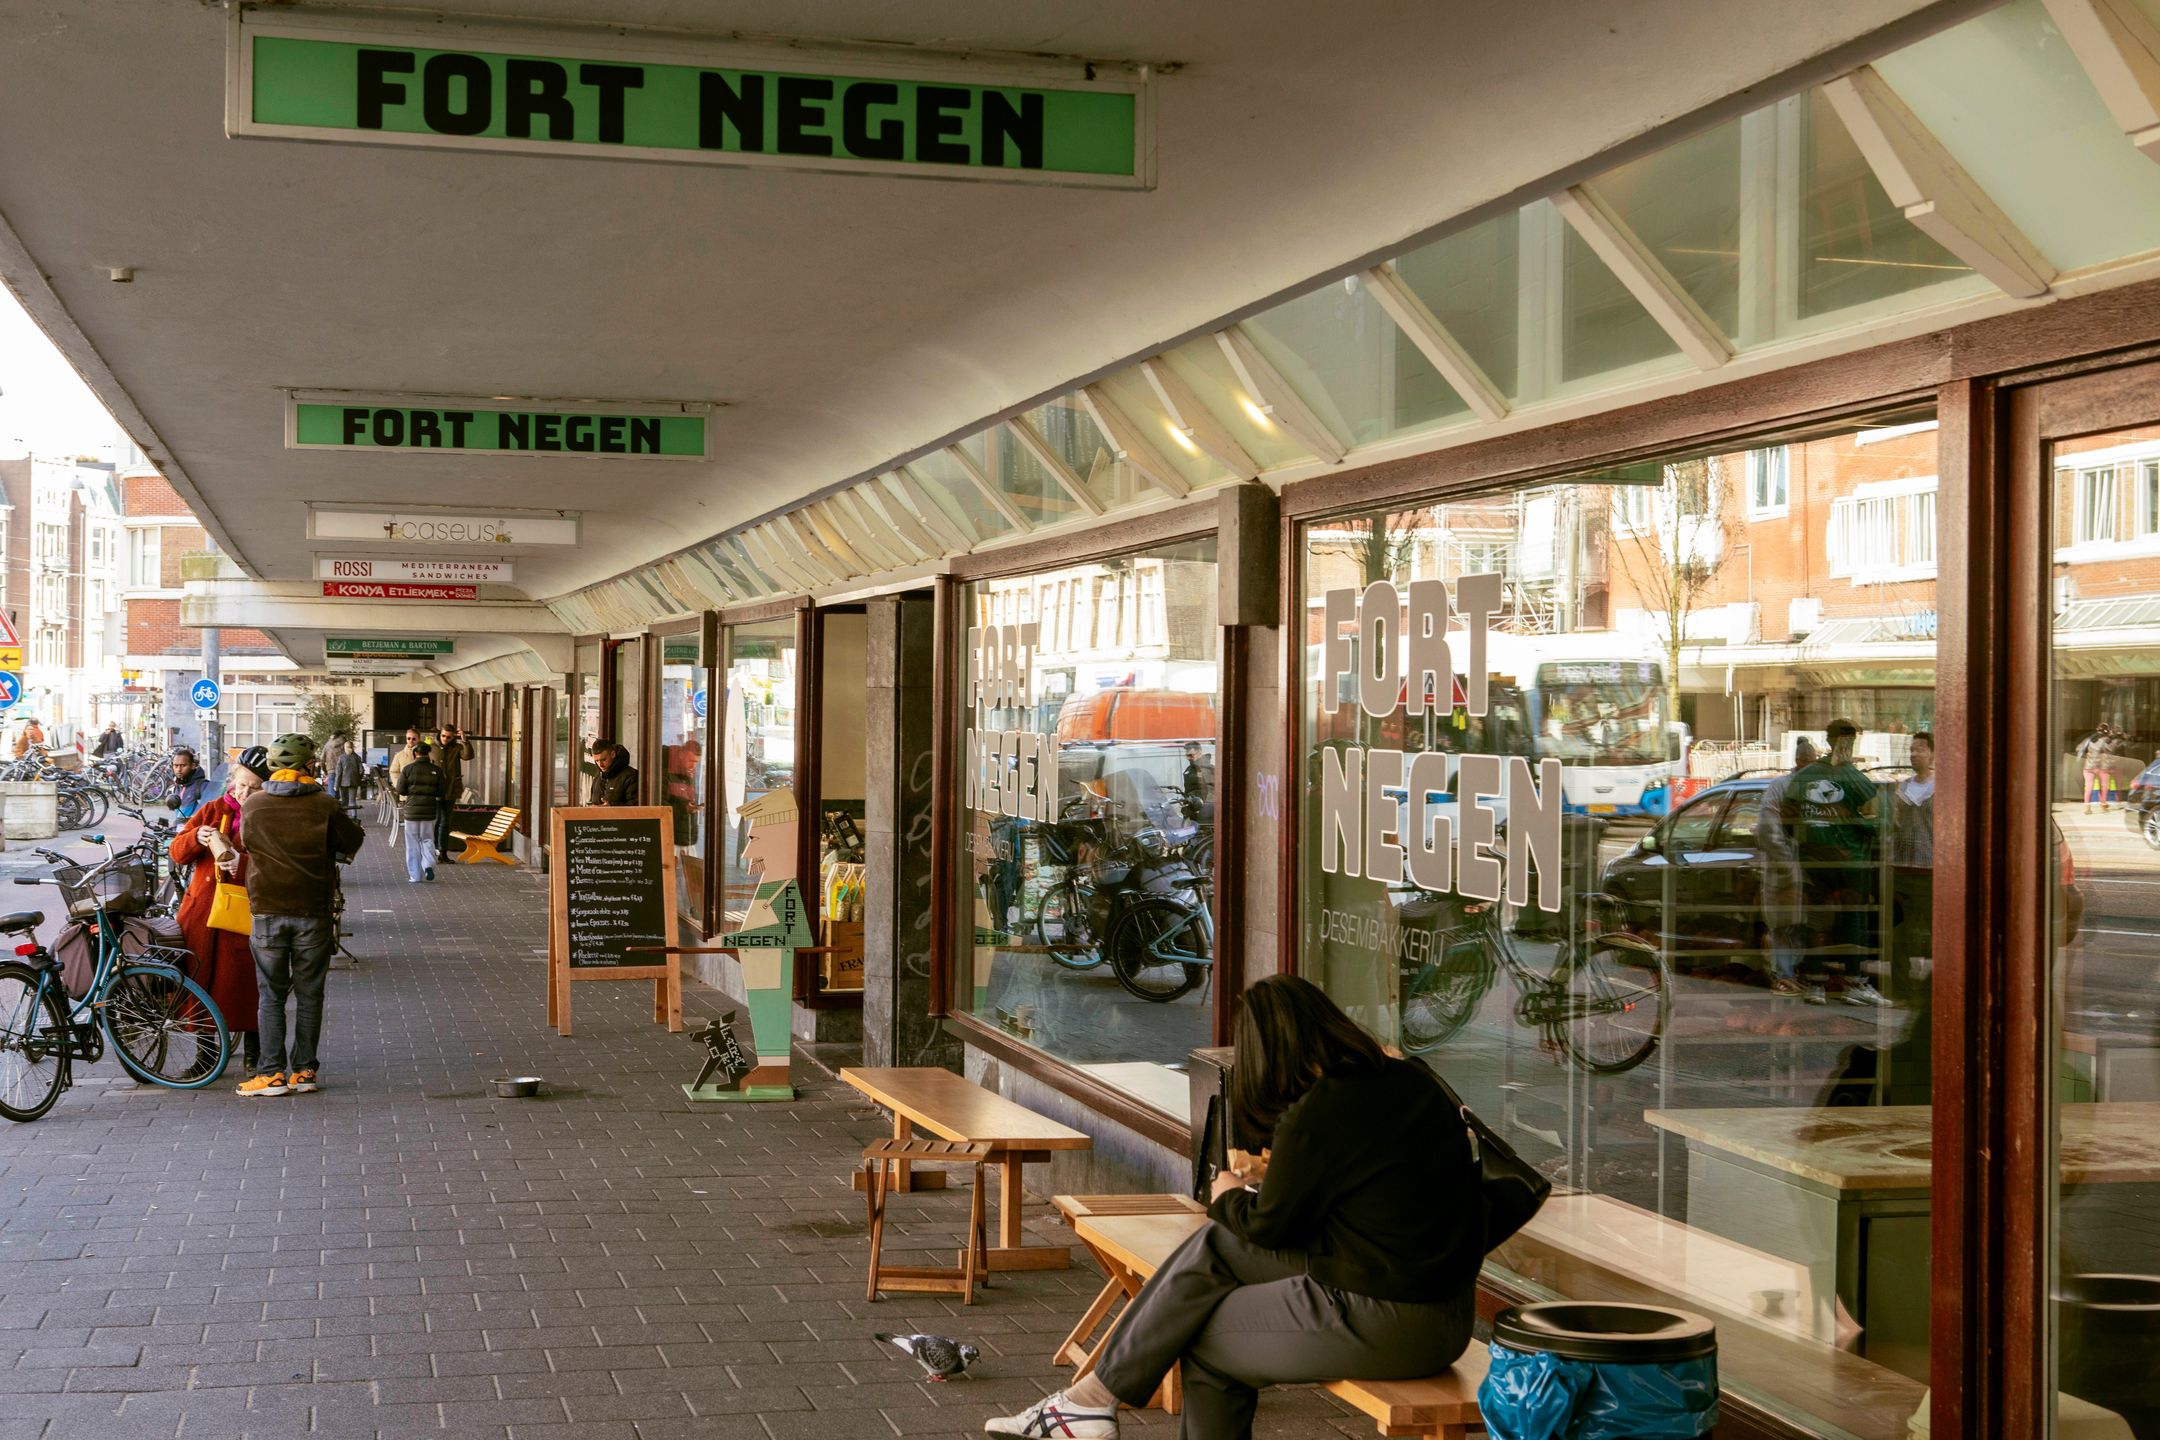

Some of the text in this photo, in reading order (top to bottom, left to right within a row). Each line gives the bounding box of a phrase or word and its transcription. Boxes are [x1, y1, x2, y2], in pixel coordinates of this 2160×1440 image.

[357, 49, 1044, 169] FORT NEGEN
[343, 408, 661, 454] FORT NEGEN
[402, 521, 495, 542] caseus
[334, 561, 499, 577] ROSSI MEDITERRANEAN
[338, 584, 385, 597] KONYA
[412, 572, 488, 580] SANDWICHES
[362, 640, 399, 648] BETJEMAN
[408, 640, 438, 649] BARTON
[967, 622, 1039, 710] FORT
[1322, 571, 1503, 718] FORT
[966, 727, 1059, 825] NEGEN
[1321, 746, 1563, 913] NEGEN
[785, 886, 796, 934] FORT
[723, 935, 786, 947] NEGEN
[1320, 908, 1444, 967] DESEMBAKKERIJ
